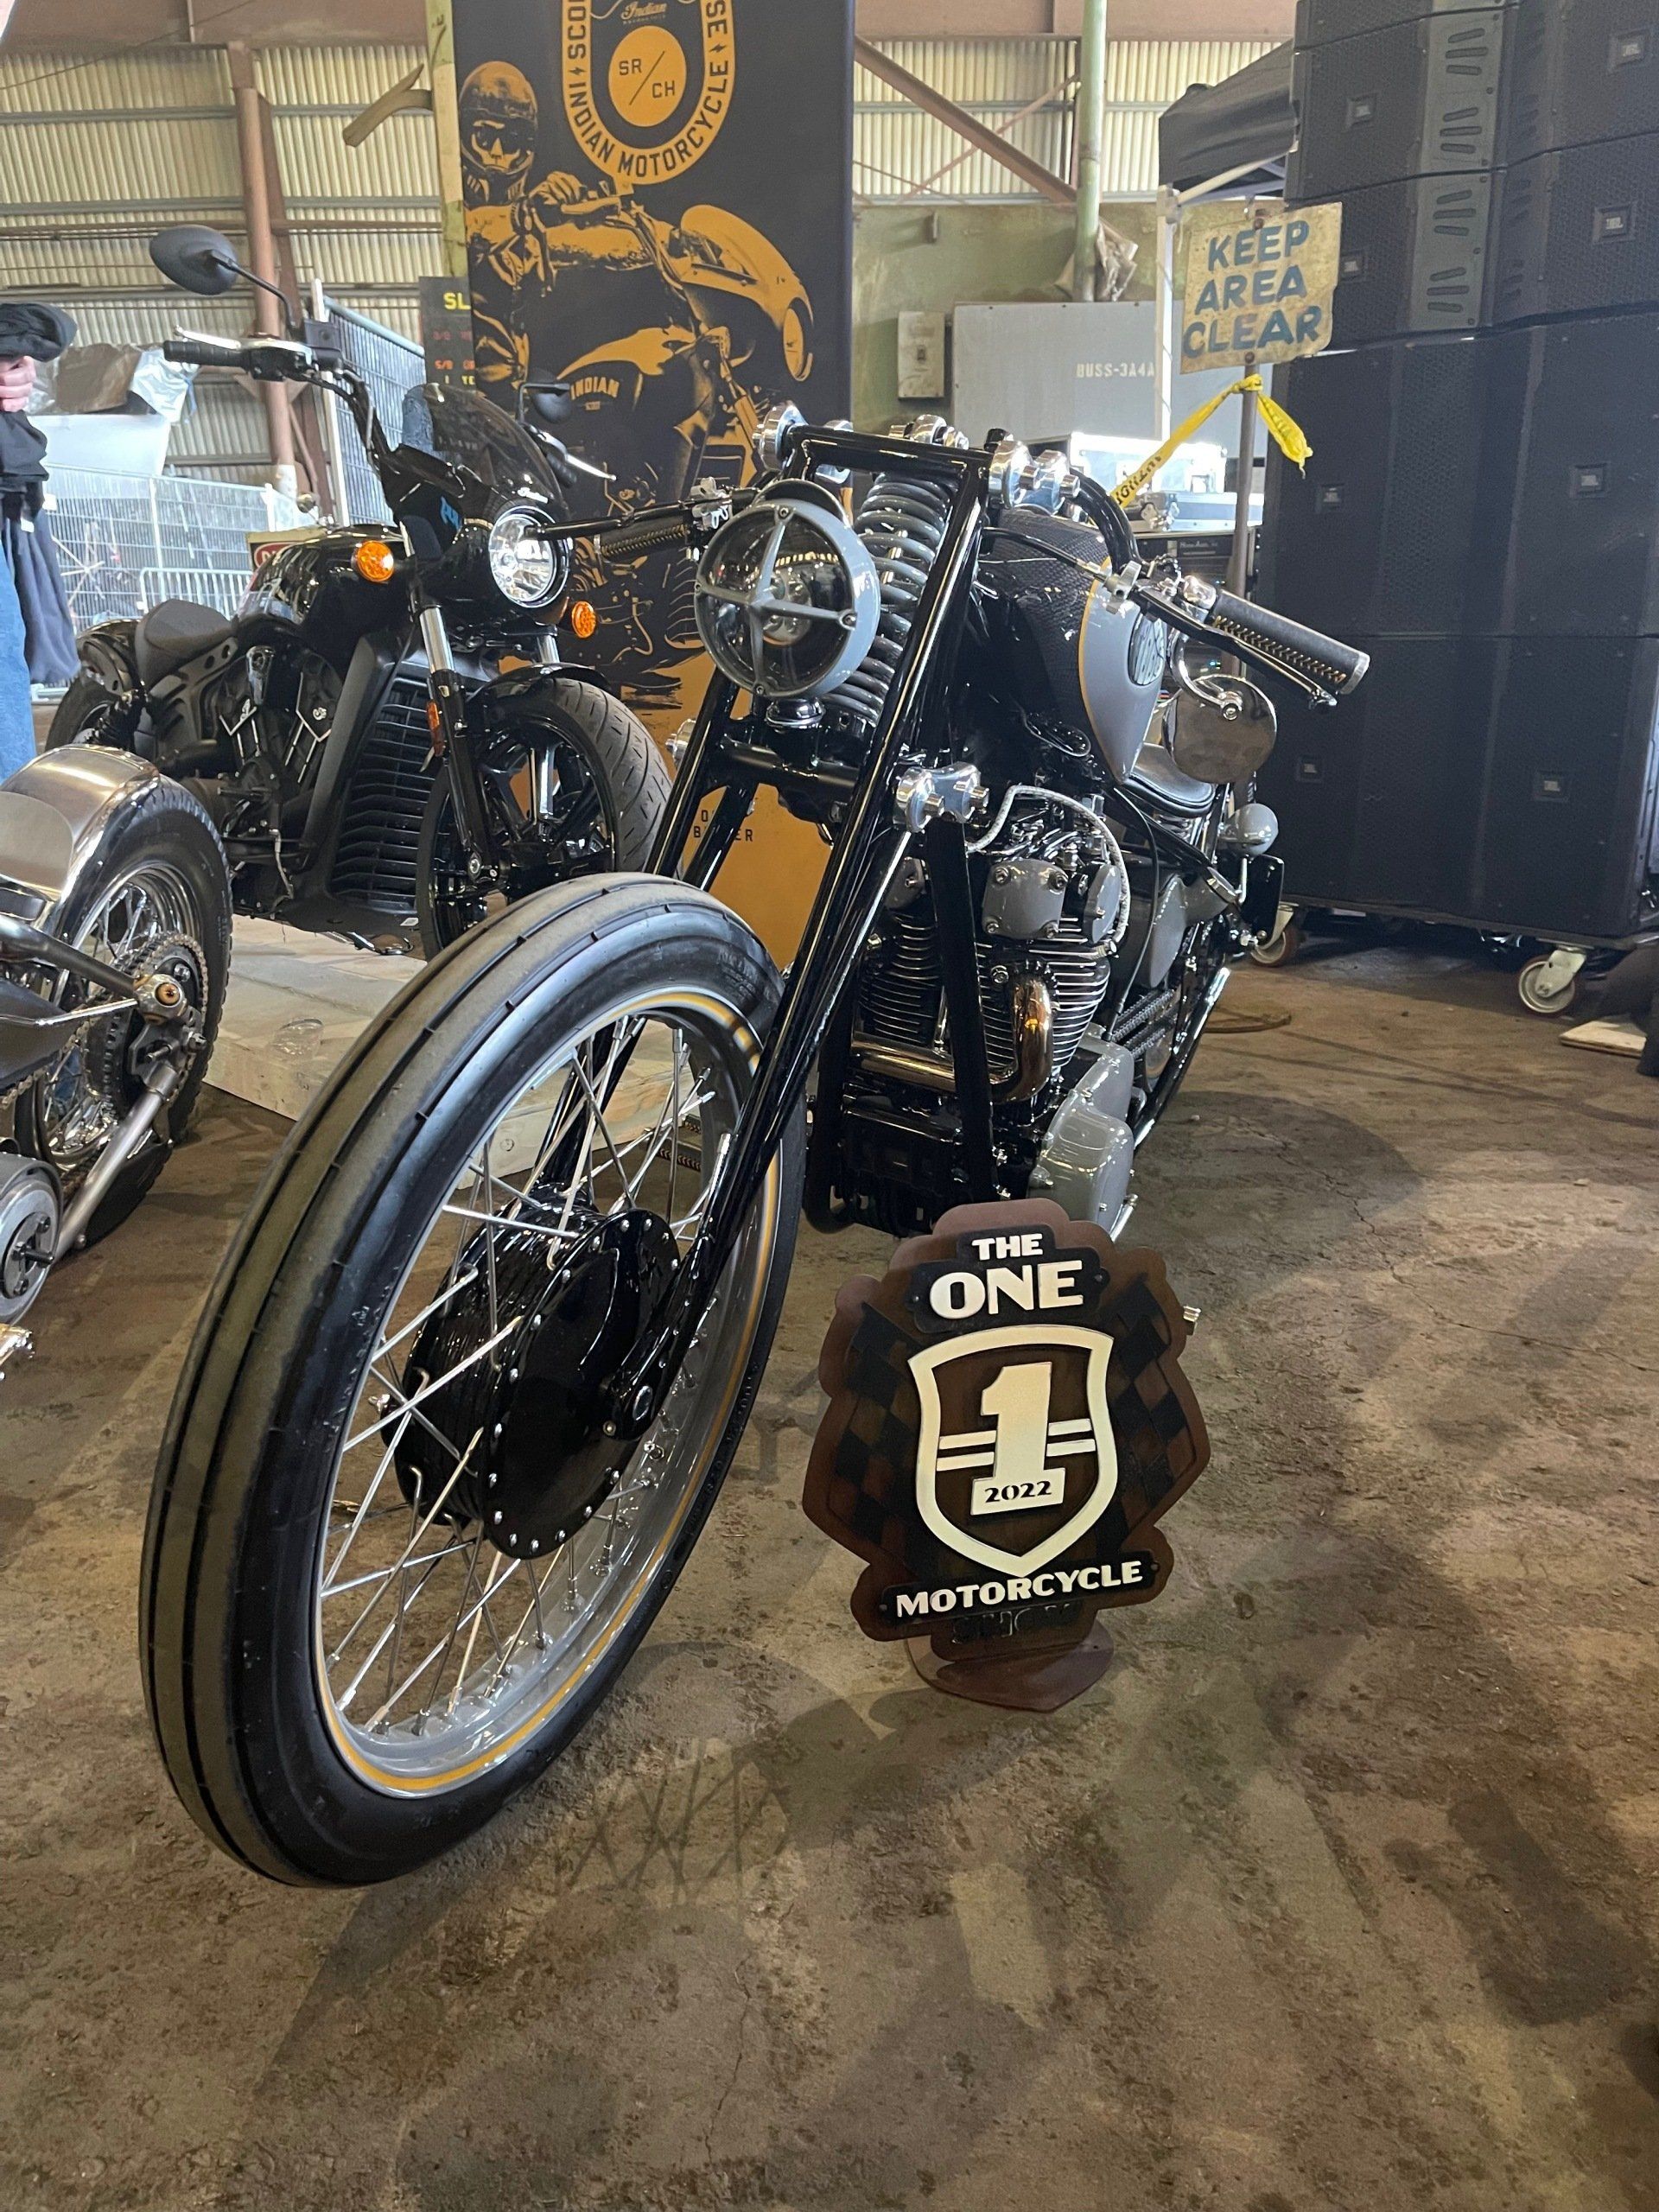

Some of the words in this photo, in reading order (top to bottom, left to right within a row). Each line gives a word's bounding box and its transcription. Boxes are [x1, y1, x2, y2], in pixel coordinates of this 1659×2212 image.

[567, 0, 587, 60] SCO
[619, 58, 642, 76] SR
[652, 79, 676, 99] CH
[569, 82, 615, 163] INDIAN
[617, 60, 729, 178] MOTORCYCLE
[1207, 220, 1310, 271] KEEP
[1194, 264, 1307, 315] AREA
[1182, 305, 1322, 359] CLEAR
[971, 1233, 1044, 1262] THE
[929, 1259, 1084, 1320] ONE
[970, 1361, 1066, 1516] 1
[983, 1480, 1052, 1503] 2022
[895, 1560, 1143, 1618] MOTORCYCLE
